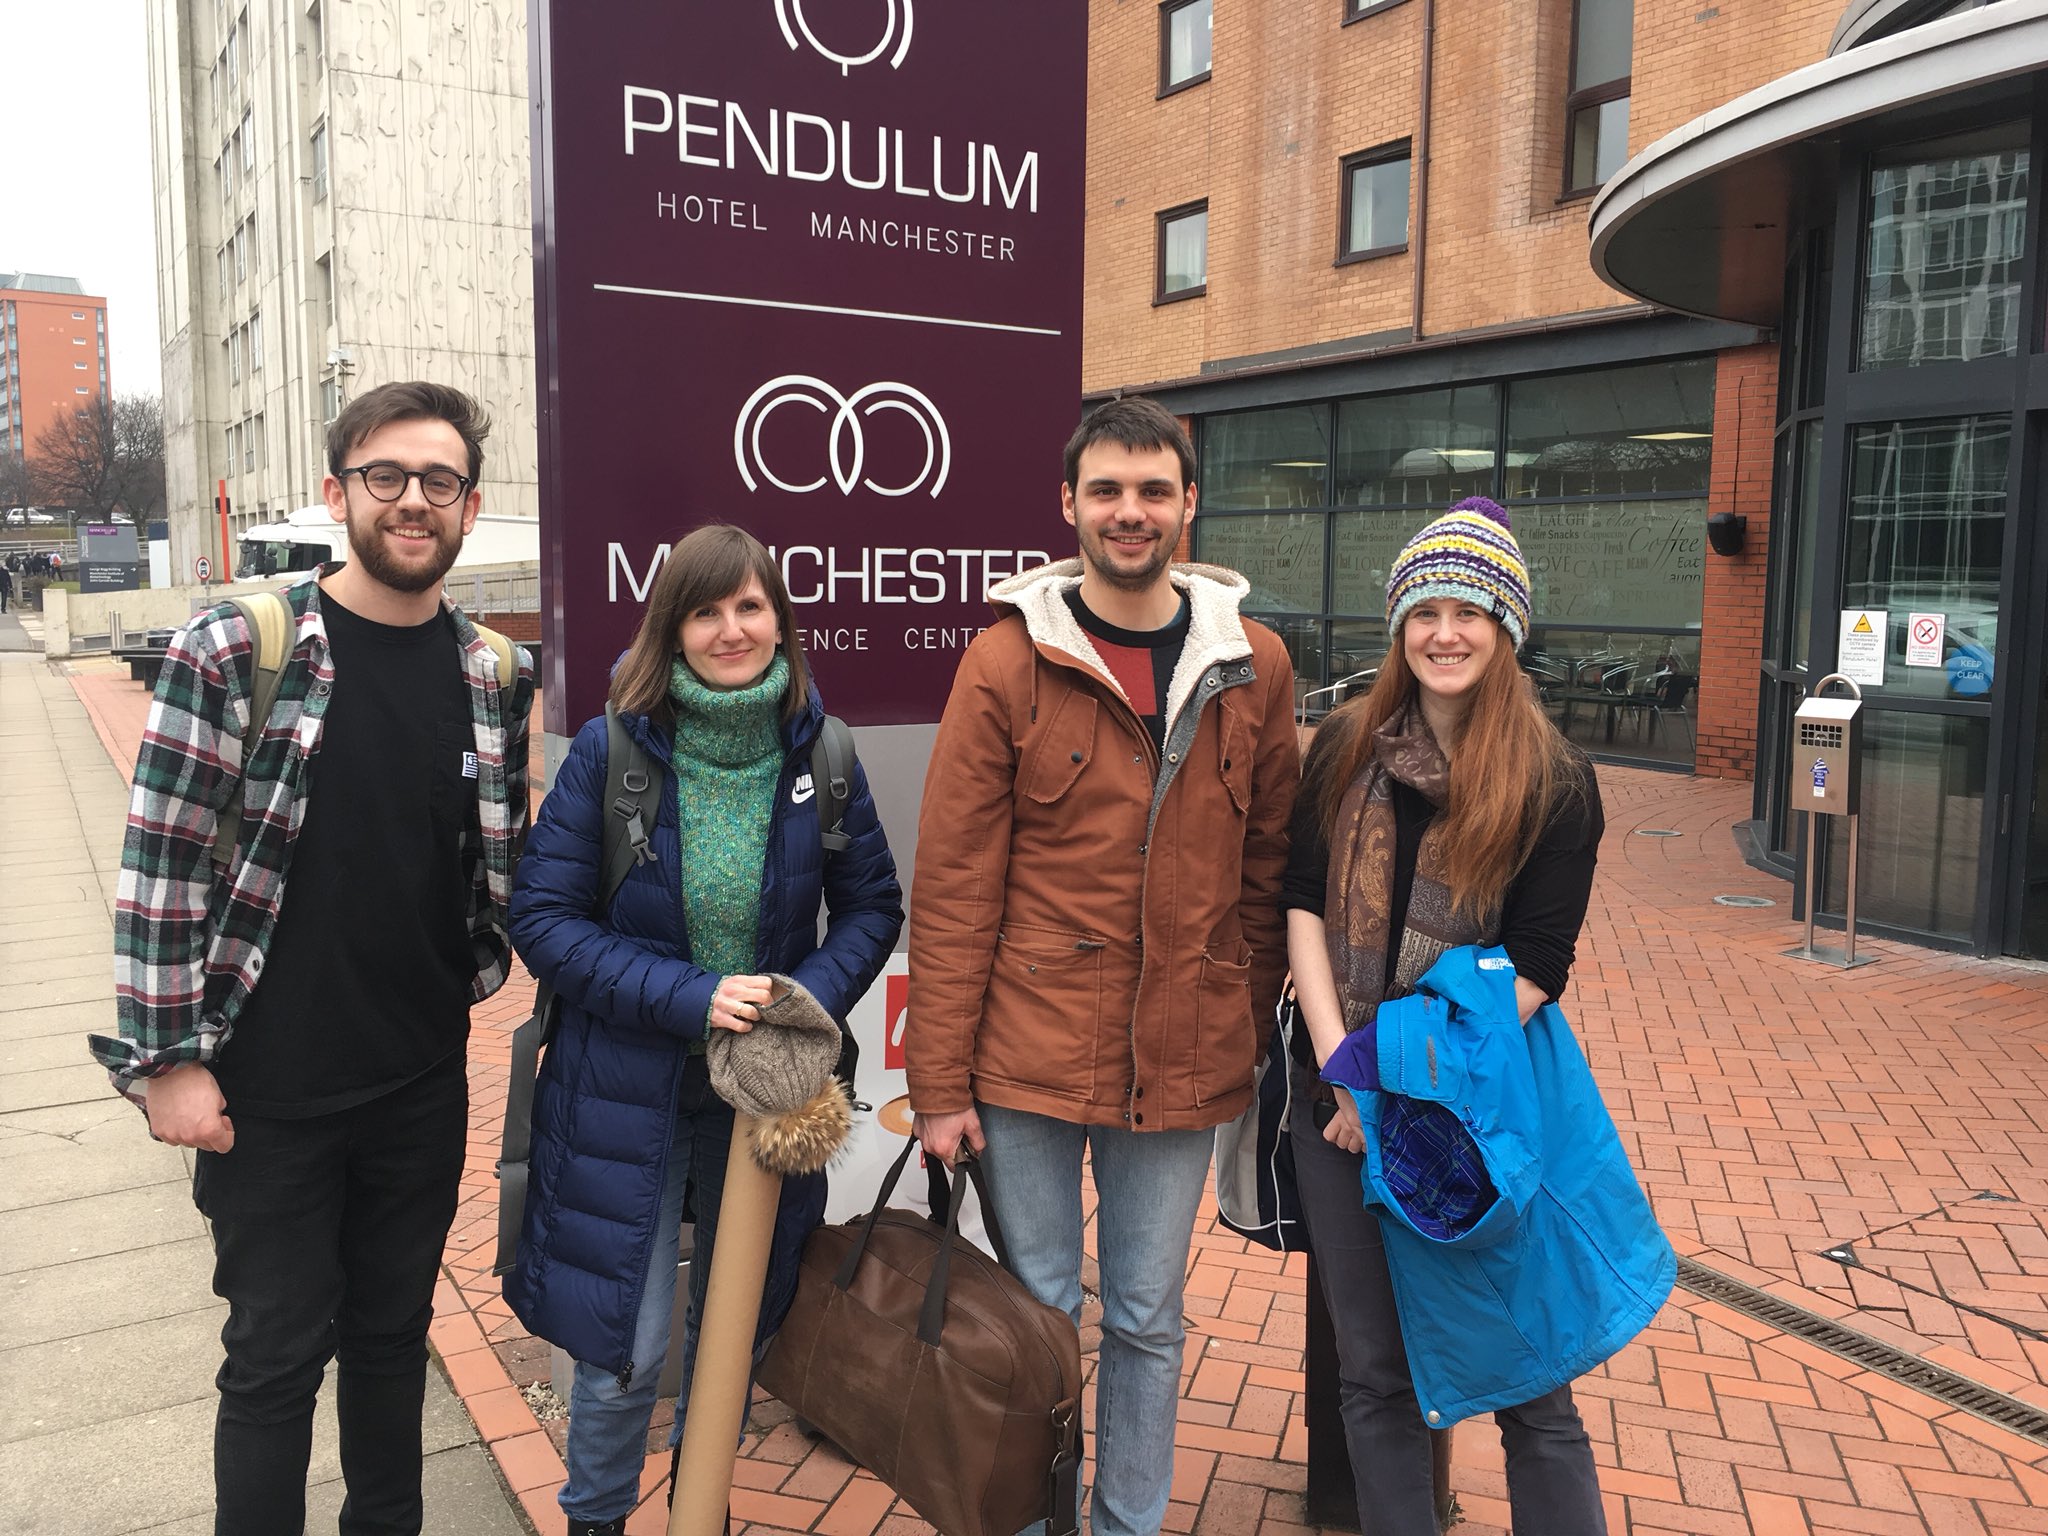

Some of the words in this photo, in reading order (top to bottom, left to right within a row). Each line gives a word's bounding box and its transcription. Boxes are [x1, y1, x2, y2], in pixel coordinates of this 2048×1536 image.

[623, 84, 1038, 213] PENDULUM
[657, 191, 768, 231] HOTEL
[811, 211, 1016, 262] MANCHESTER
[1540, 513, 1585, 527] LAUGH
[1547, 529, 1580, 540] Snacks
[1530, 555, 1570, 573] LOVE
[1573, 559, 1624, 579] CAFE
[1677, 556, 1702, 569] Eat
[607, 542, 1050, 604] MCHESTE
[1961, 659, 1983, 668] KEEP
[1957, 670, 1984, 681] CLEAR
